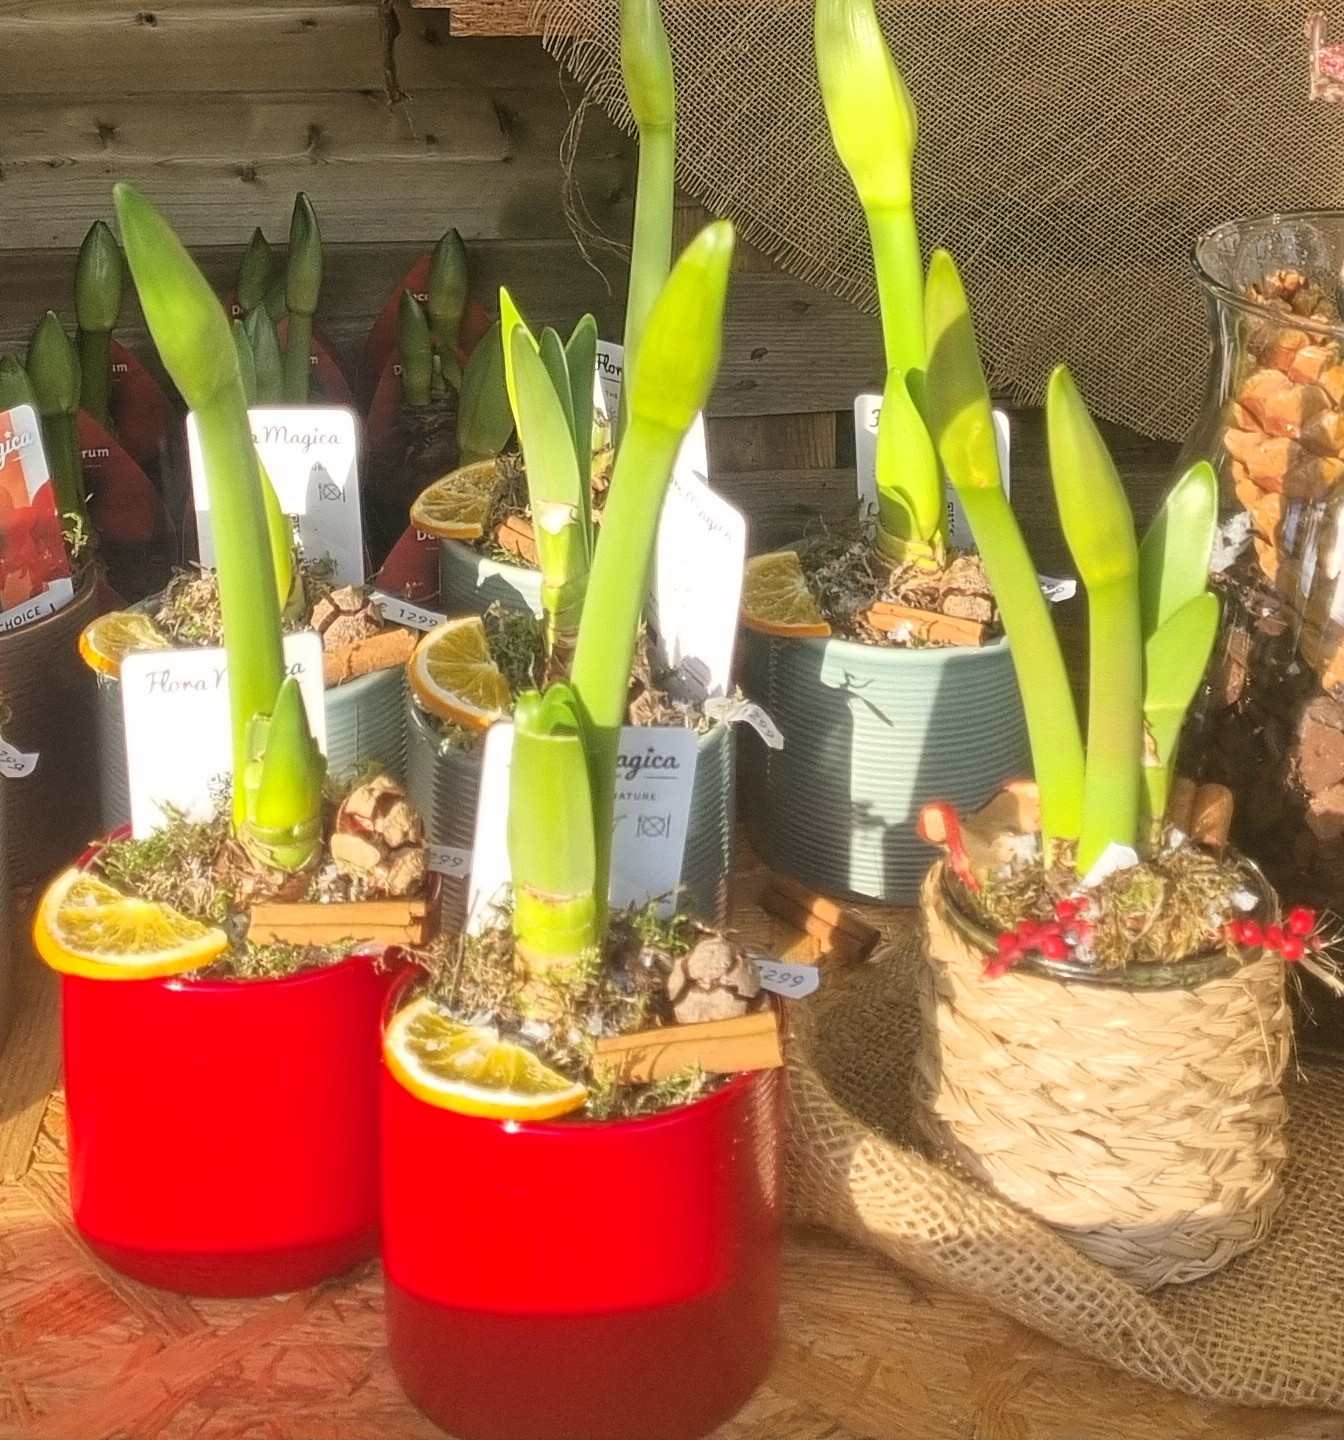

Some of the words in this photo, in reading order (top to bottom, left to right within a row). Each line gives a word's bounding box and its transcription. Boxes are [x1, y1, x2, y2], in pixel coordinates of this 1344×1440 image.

[595, 352, 623, 376] Flor
[263, 425, 341, 453] Magica
[145, 668, 206, 696] Flora
[615, 746, 681, 780] agica
